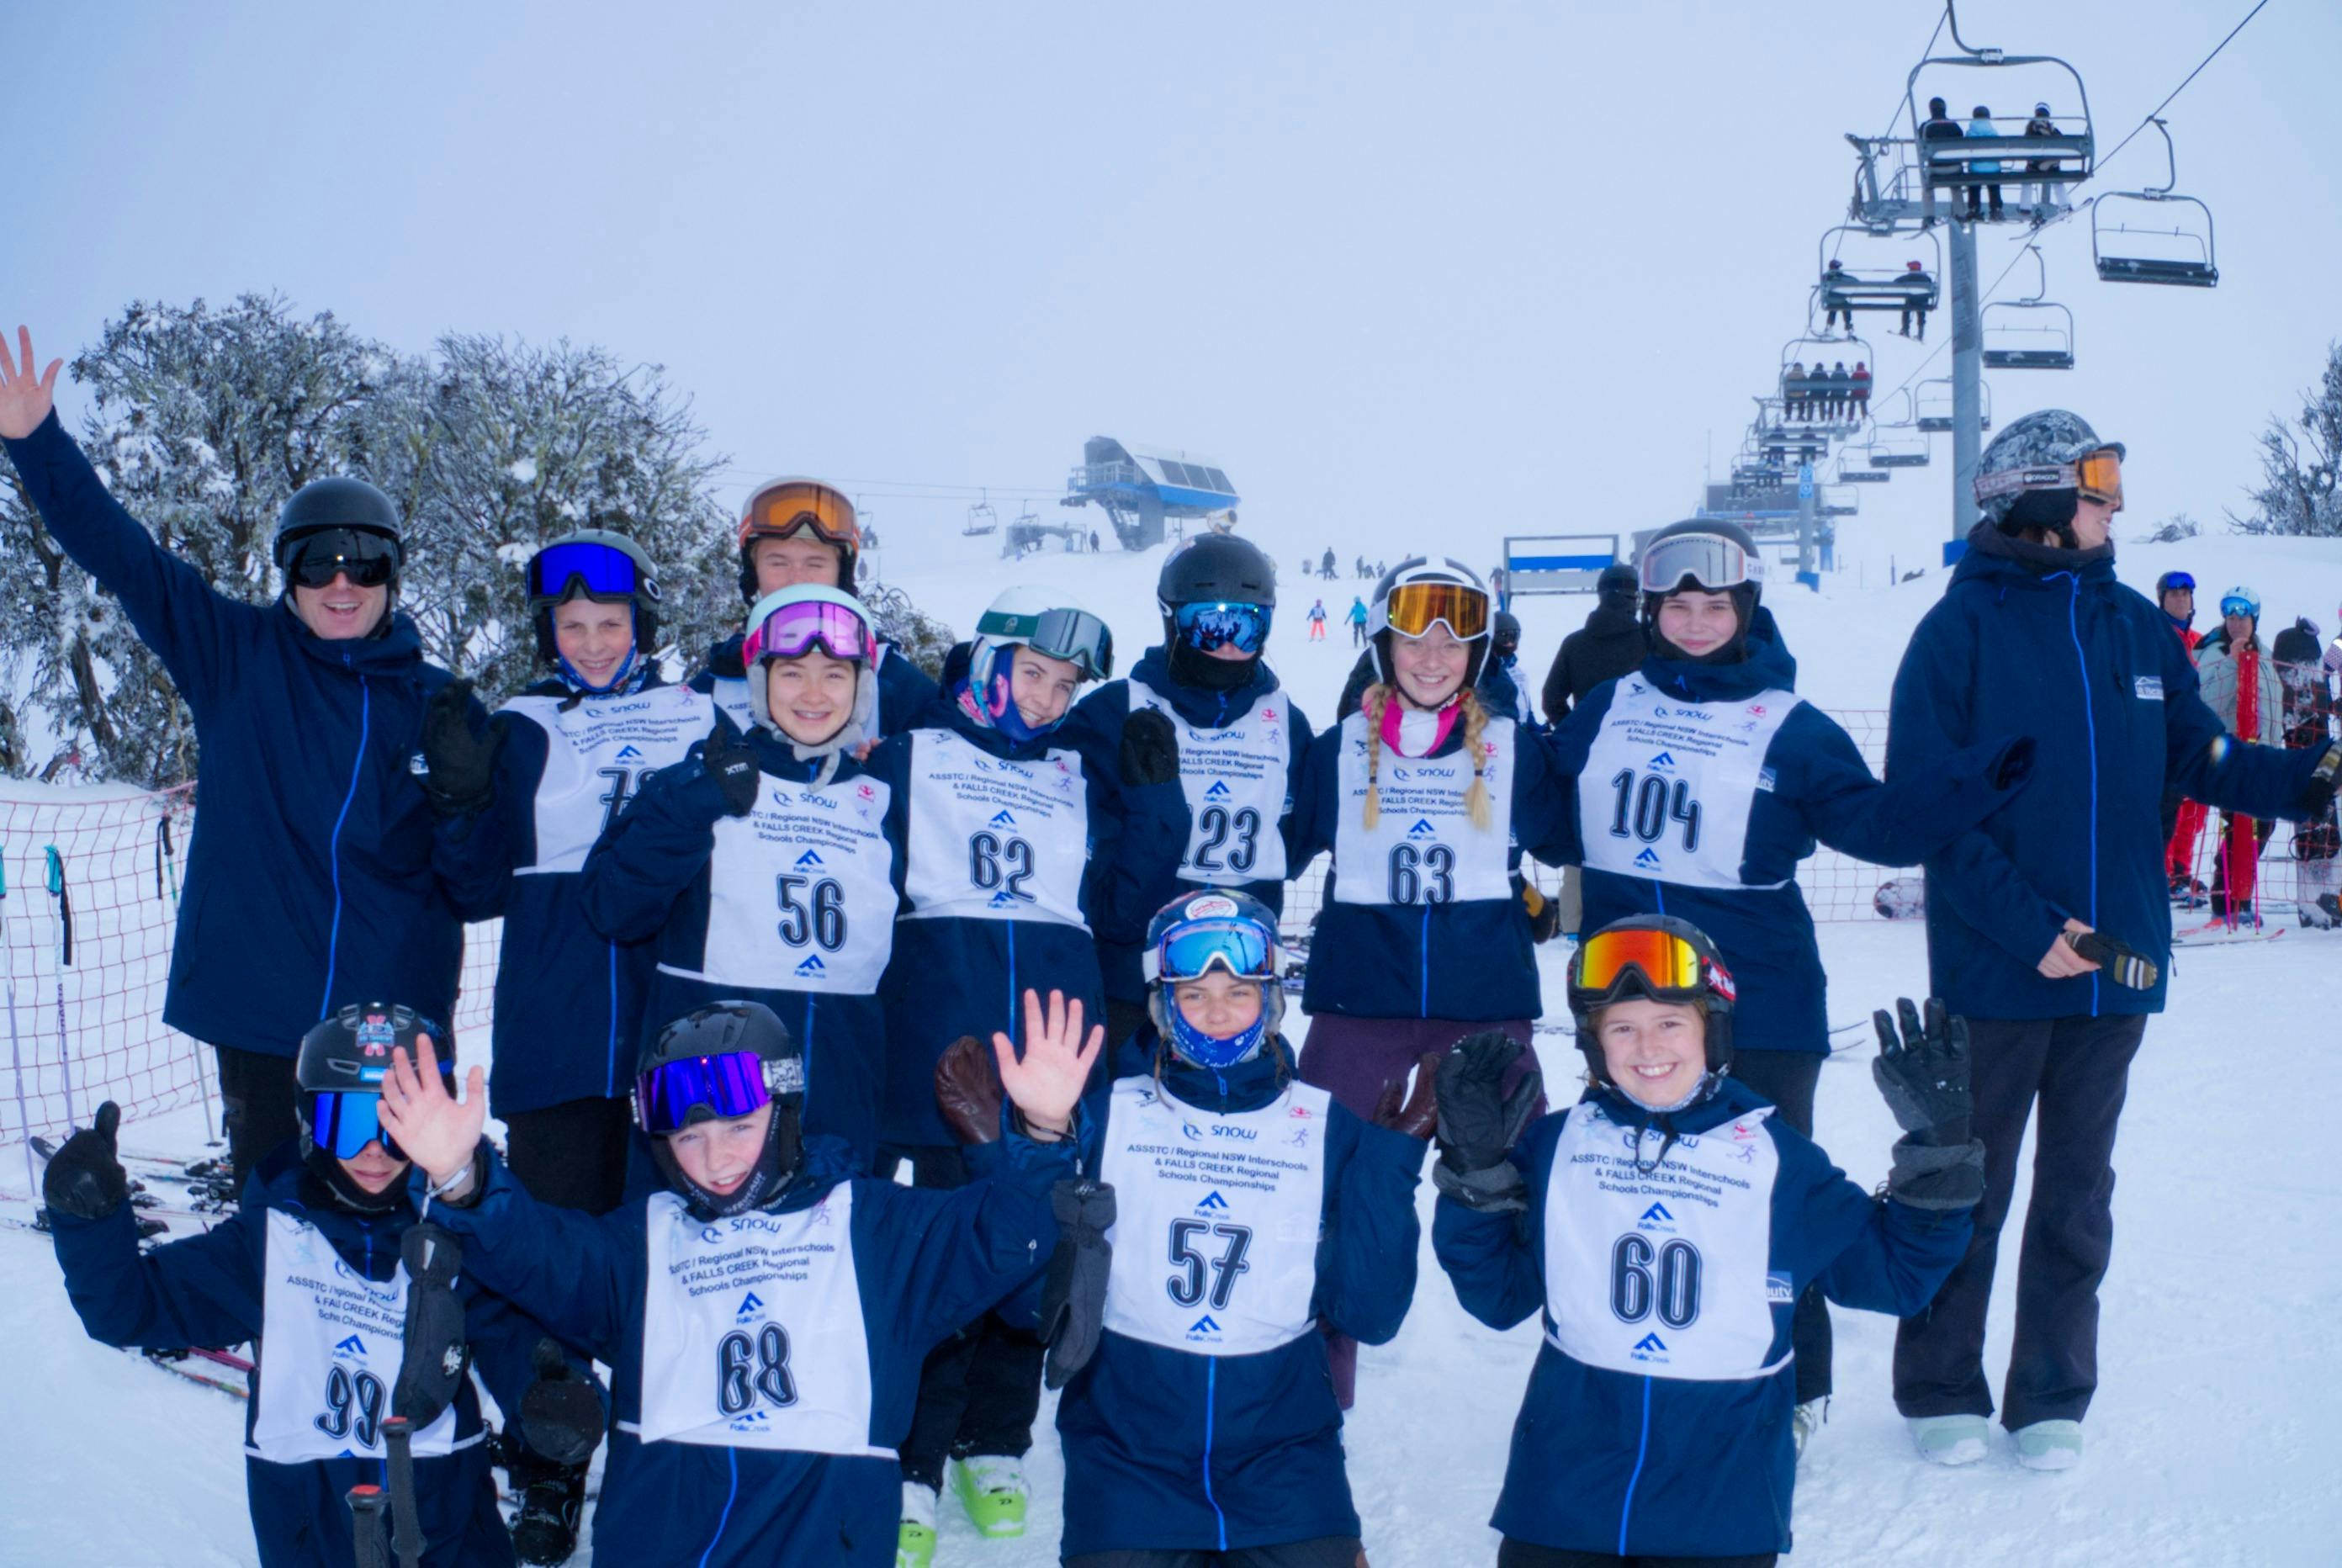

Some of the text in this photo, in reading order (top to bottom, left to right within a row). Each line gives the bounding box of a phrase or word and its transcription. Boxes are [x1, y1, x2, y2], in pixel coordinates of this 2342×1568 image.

[611, 702, 651, 713] snow
[1676, 707, 1714, 721] snow
[642, 726, 678, 735] Regional
[649, 715, 702, 725] Interschools
[1634, 728, 1656, 736] FALLS
[1656, 731, 1685, 741] CREEK
[1686, 736, 1723, 748] Regional
[1644, 721, 1676, 730] Regional
[1677, 726, 1697, 734] NSW
[1698, 730, 1749, 746] Interschools
[1185, 748, 1220, 756] Regional
[1222, 749, 1240, 757] NSW
[1627, 735, 1717, 756] Schools Championships
[998, 760, 1035, 779] snow
[1205, 758, 1233, 766] CREEK
[1234, 760, 1264, 769] Regional
[1206, 768, 1264, 779] Championships
[1417, 768, 1455, 778] snow
[971, 773, 1006, 787] Regional
[1008, 782, 1028, 792] NSW
[1390, 787, 1425, 796] Regional
[799, 792, 838, 809] snow
[956, 792, 1052, 818] Schools Championships
[962, 782, 988, 792] FALLS
[989, 786, 1019, 799] CREEK
[1020, 793, 1054, 809] Regional
[771, 812, 810, 823] Regional
[812, 817, 831, 826] NSW
[1609, 768, 1702, 853] 104
[758, 832, 856, 854] Schools Championships
[761, 822, 790, 832] FALLS
[792, 824, 824, 834] CREEK
[825, 829, 858, 845] Regional
[969, 830, 1038, 903] 62
[1388, 842, 1456, 905] 63
[776, 873, 847, 952] 56
[1211, 1125, 1258, 1140] snow
[1127, 1144, 1169, 1155] ASSSTC
[1177, 1147, 1220, 1159] Regional
[1221, 1152, 1246, 1162] NSW
[1248, 1155, 1308, 1172] Interschools
[1154, 1157, 1280, 1179] & FALLS CREEK Regional
[1158, 1169, 1276, 1191] Schools Championships
[1571, 1154, 1609, 1165] ASSSTC
[1661, 1159, 1688, 1171] NSW
[1690, 1165, 1751, 1189] Interschools
[1595, 1168, 1722, 1195] & FALLS CREEK Regional
[1598, 1181, 1719, 1208] Schools Championships
[731, 1218, 782, 1233] snow
[698, 1248, 744, 1266] Regional
[744, 1246, 769, 1257] NSW
[771, 1242, 835, 1257] Interschools
[1167, 1217, 1253, 1311] 57
[681, 1257, 810, 1285] & FALLS CREEK Regional
[1610, 1232, 1703, 1331] 60
[287, 1275, 327, 1293] ASSSTC
[688, 1270, 808, 1296] Schools Championships
[315, 1295, 321, 1304] &
[342, 1301, 379, 1320] CREEK
[717, 1321, 798, 1417] 68
[314, 1363, 387, 1450] 99
